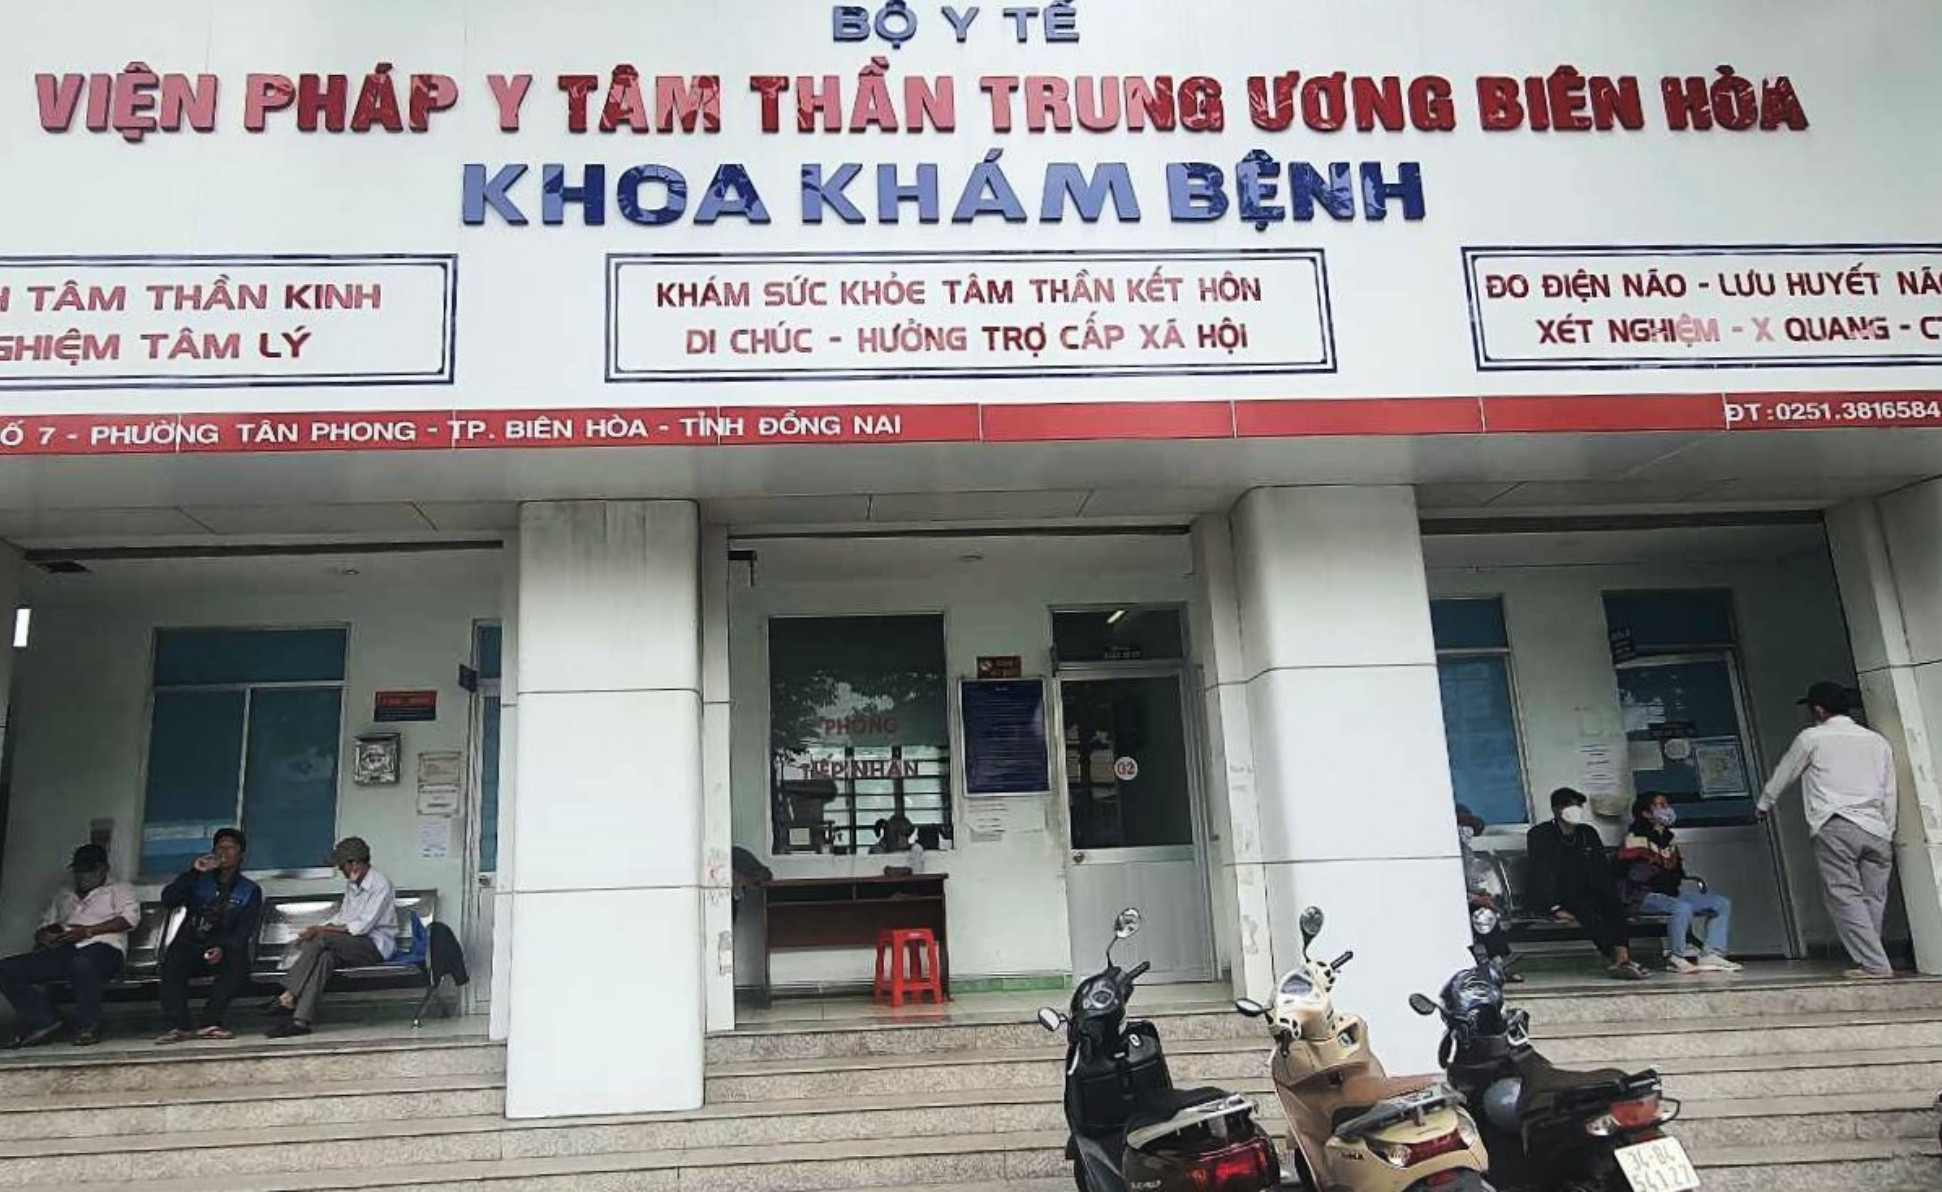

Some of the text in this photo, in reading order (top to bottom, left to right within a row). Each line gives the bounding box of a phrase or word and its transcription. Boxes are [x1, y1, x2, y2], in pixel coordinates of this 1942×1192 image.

[833, 0, 1080, 49] BỘ Y TẾ
[35, 62, 219, 142] VIỆN
[244, 63, 459, 133] PHÁP
[487, 74, 533, 133] Y
[558, 65, 721, 133] TÂM
[751, 56, 955, 133] THẦN
[980, 76, 1224, 133] TRUNG
[1247, 71, 1456, 132] ƯƠNG
[1476, 64, 1645, 131] BIÊN
[463, 148, 1426, 231] KHOA KHÁM BỆNH
[27, 279, 126, 312] TÂM
[146, 274, 268, 311] THẦN
[284, 284, 381, 309] KINH
[656, 265, 1262, 307] KHÁM SỨC KHỎE TÂM THẦN KẾT HÔN
[1486, 273, 1530, 299] ĐO
[1541, 268, 1612, 303] ĐIỆN
[1622, 268, 1688, 298] NÃO
[1718, 268, 1776, 297] LƯU
[1786, 262, 1880, 296] HUYẾT
[140, 327, 241, 359] TÂM
[259, 325, 312, 359] LÝ
[686, 328, 716, 354] DI
[730, 320, 813, 354] CHÚC
[857, 318, 968, 353] HƯỞNG
[981, 322, 1047, 358] TRỢ
[1060, 311, 1125, 350] CẤP
[1138, 318, 1186, 350] XÃ
[1197, 317, 1249, 355] HỘI
[1536, 313, 1593, 344] XÉT
[1608, 313, 1721, 348] NGHIỆM
[1751, 317, 1776, 343] X
[1784, 317, 1890, 343] QUANG
[38, 427, 56, 445] 7
[90, 420, 220, 446] PHƯỜNG
[236, 420, 299, 443] TÂN
[310, 421, 417, 442] PHONG
[447, 420, 496, 440] TP.
[505, 416, 573, 439] BIÊN
[585, 413, 649, 438] HÒA
[680, 410, 744, 437] TỈNH
[758, 408, 841, 436] ĐỒNG
[853, 415, 901, 435] NAI
[1117, 761, 1135, 775] 02
